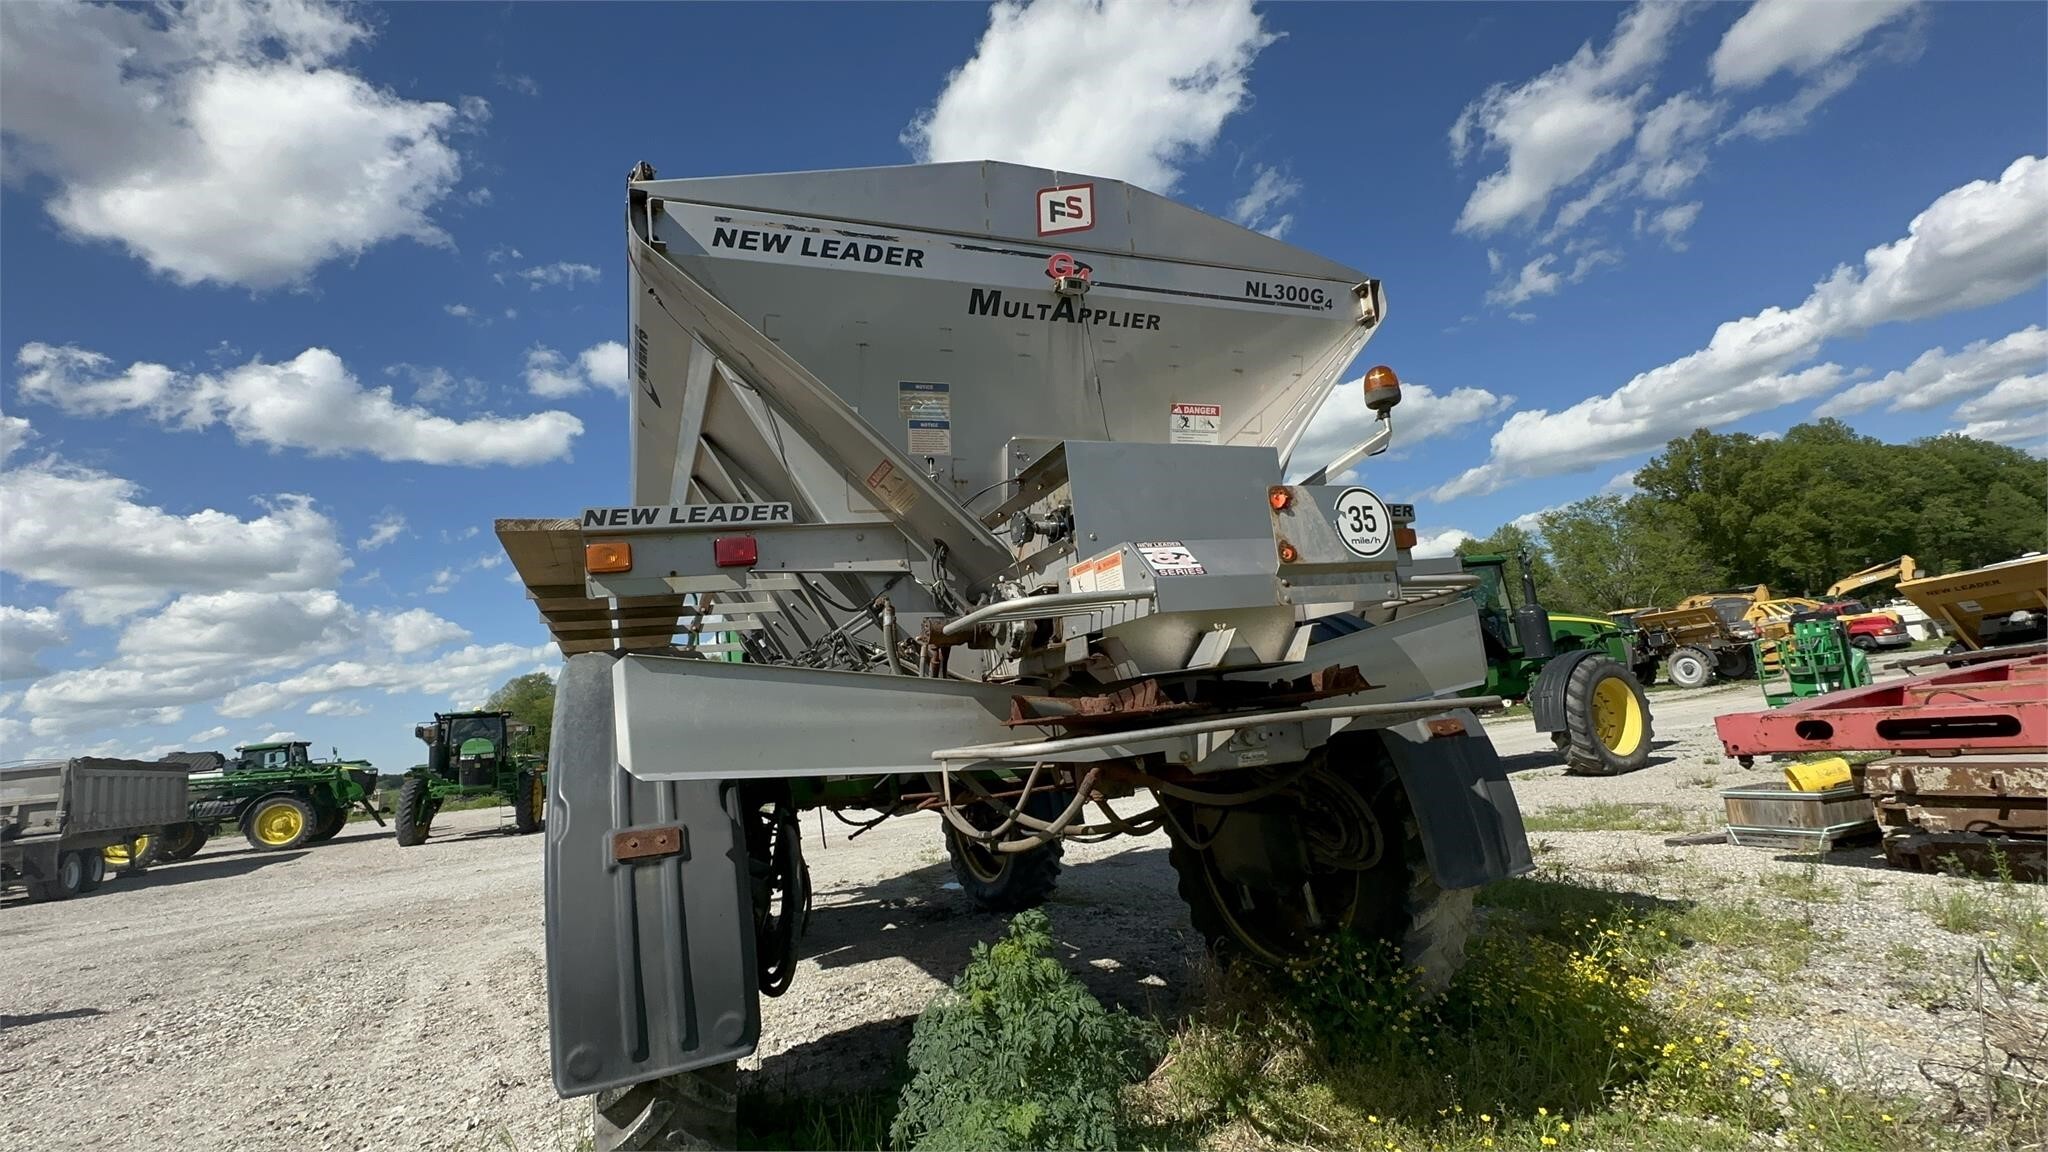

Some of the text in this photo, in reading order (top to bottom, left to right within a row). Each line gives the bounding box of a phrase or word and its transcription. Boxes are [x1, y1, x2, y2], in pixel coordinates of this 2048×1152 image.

[1049, 196, 1083, 223] FS
[712, 227, 925, 268] NEW LEADER
[1183, 406, 1217, 415] DANGER
[583, 504, 789, 527] NEW LEADER
[1348, 505, 1377, 533] 35
[1351, 536, 1381, 545] mile/h
[1158, 566, 1205, 577] SERIES
[1926, 580, 2002, 596] NEW LEADER
